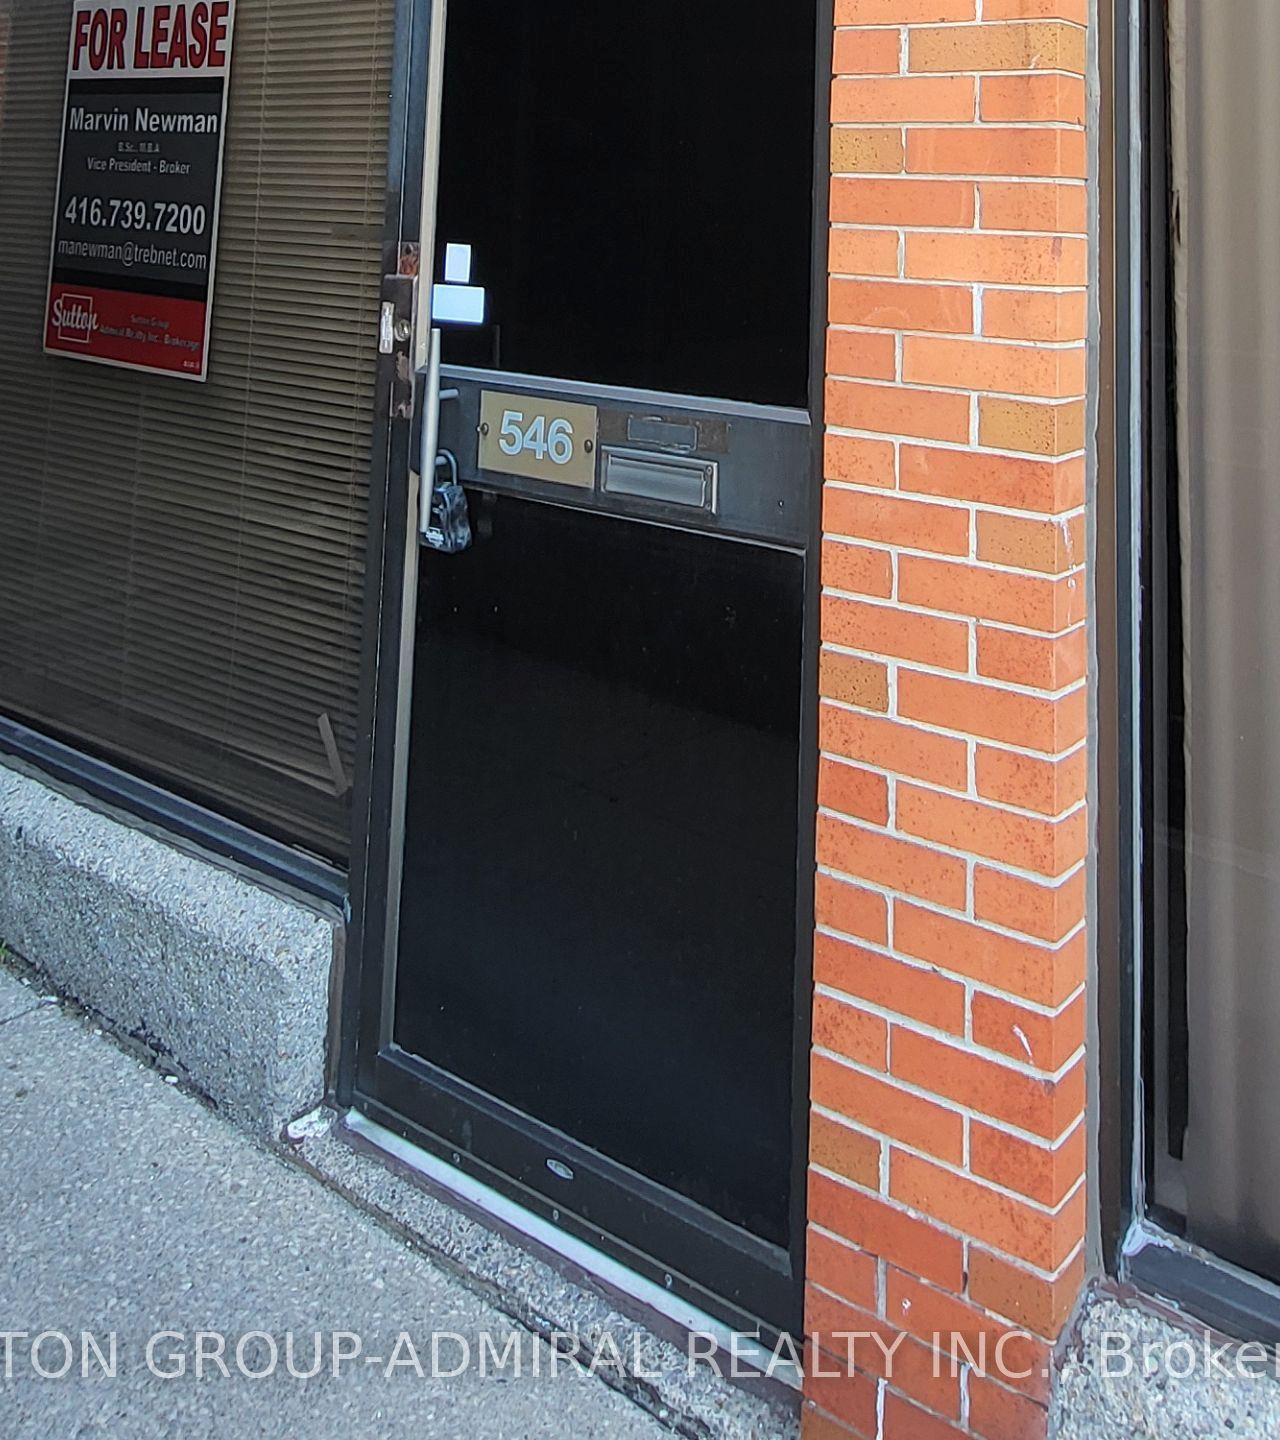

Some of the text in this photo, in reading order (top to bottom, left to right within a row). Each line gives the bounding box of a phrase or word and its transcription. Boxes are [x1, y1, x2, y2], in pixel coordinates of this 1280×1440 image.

[72, 1, 230, 71] FOR LEASE
[70, 107, 218, 133] Marvin Newman
[87, 157, 107, 171] Vice
[109, 158, 151, 173] President
[159, 159, 191, 175] Broker
[65, 196, 206, 235] 416.739.7200
[58, 240, 207, 270] manewman@trebnet.com
[52, 298, 99, 330] Sutton
[498, 409, 574, 465] 546
